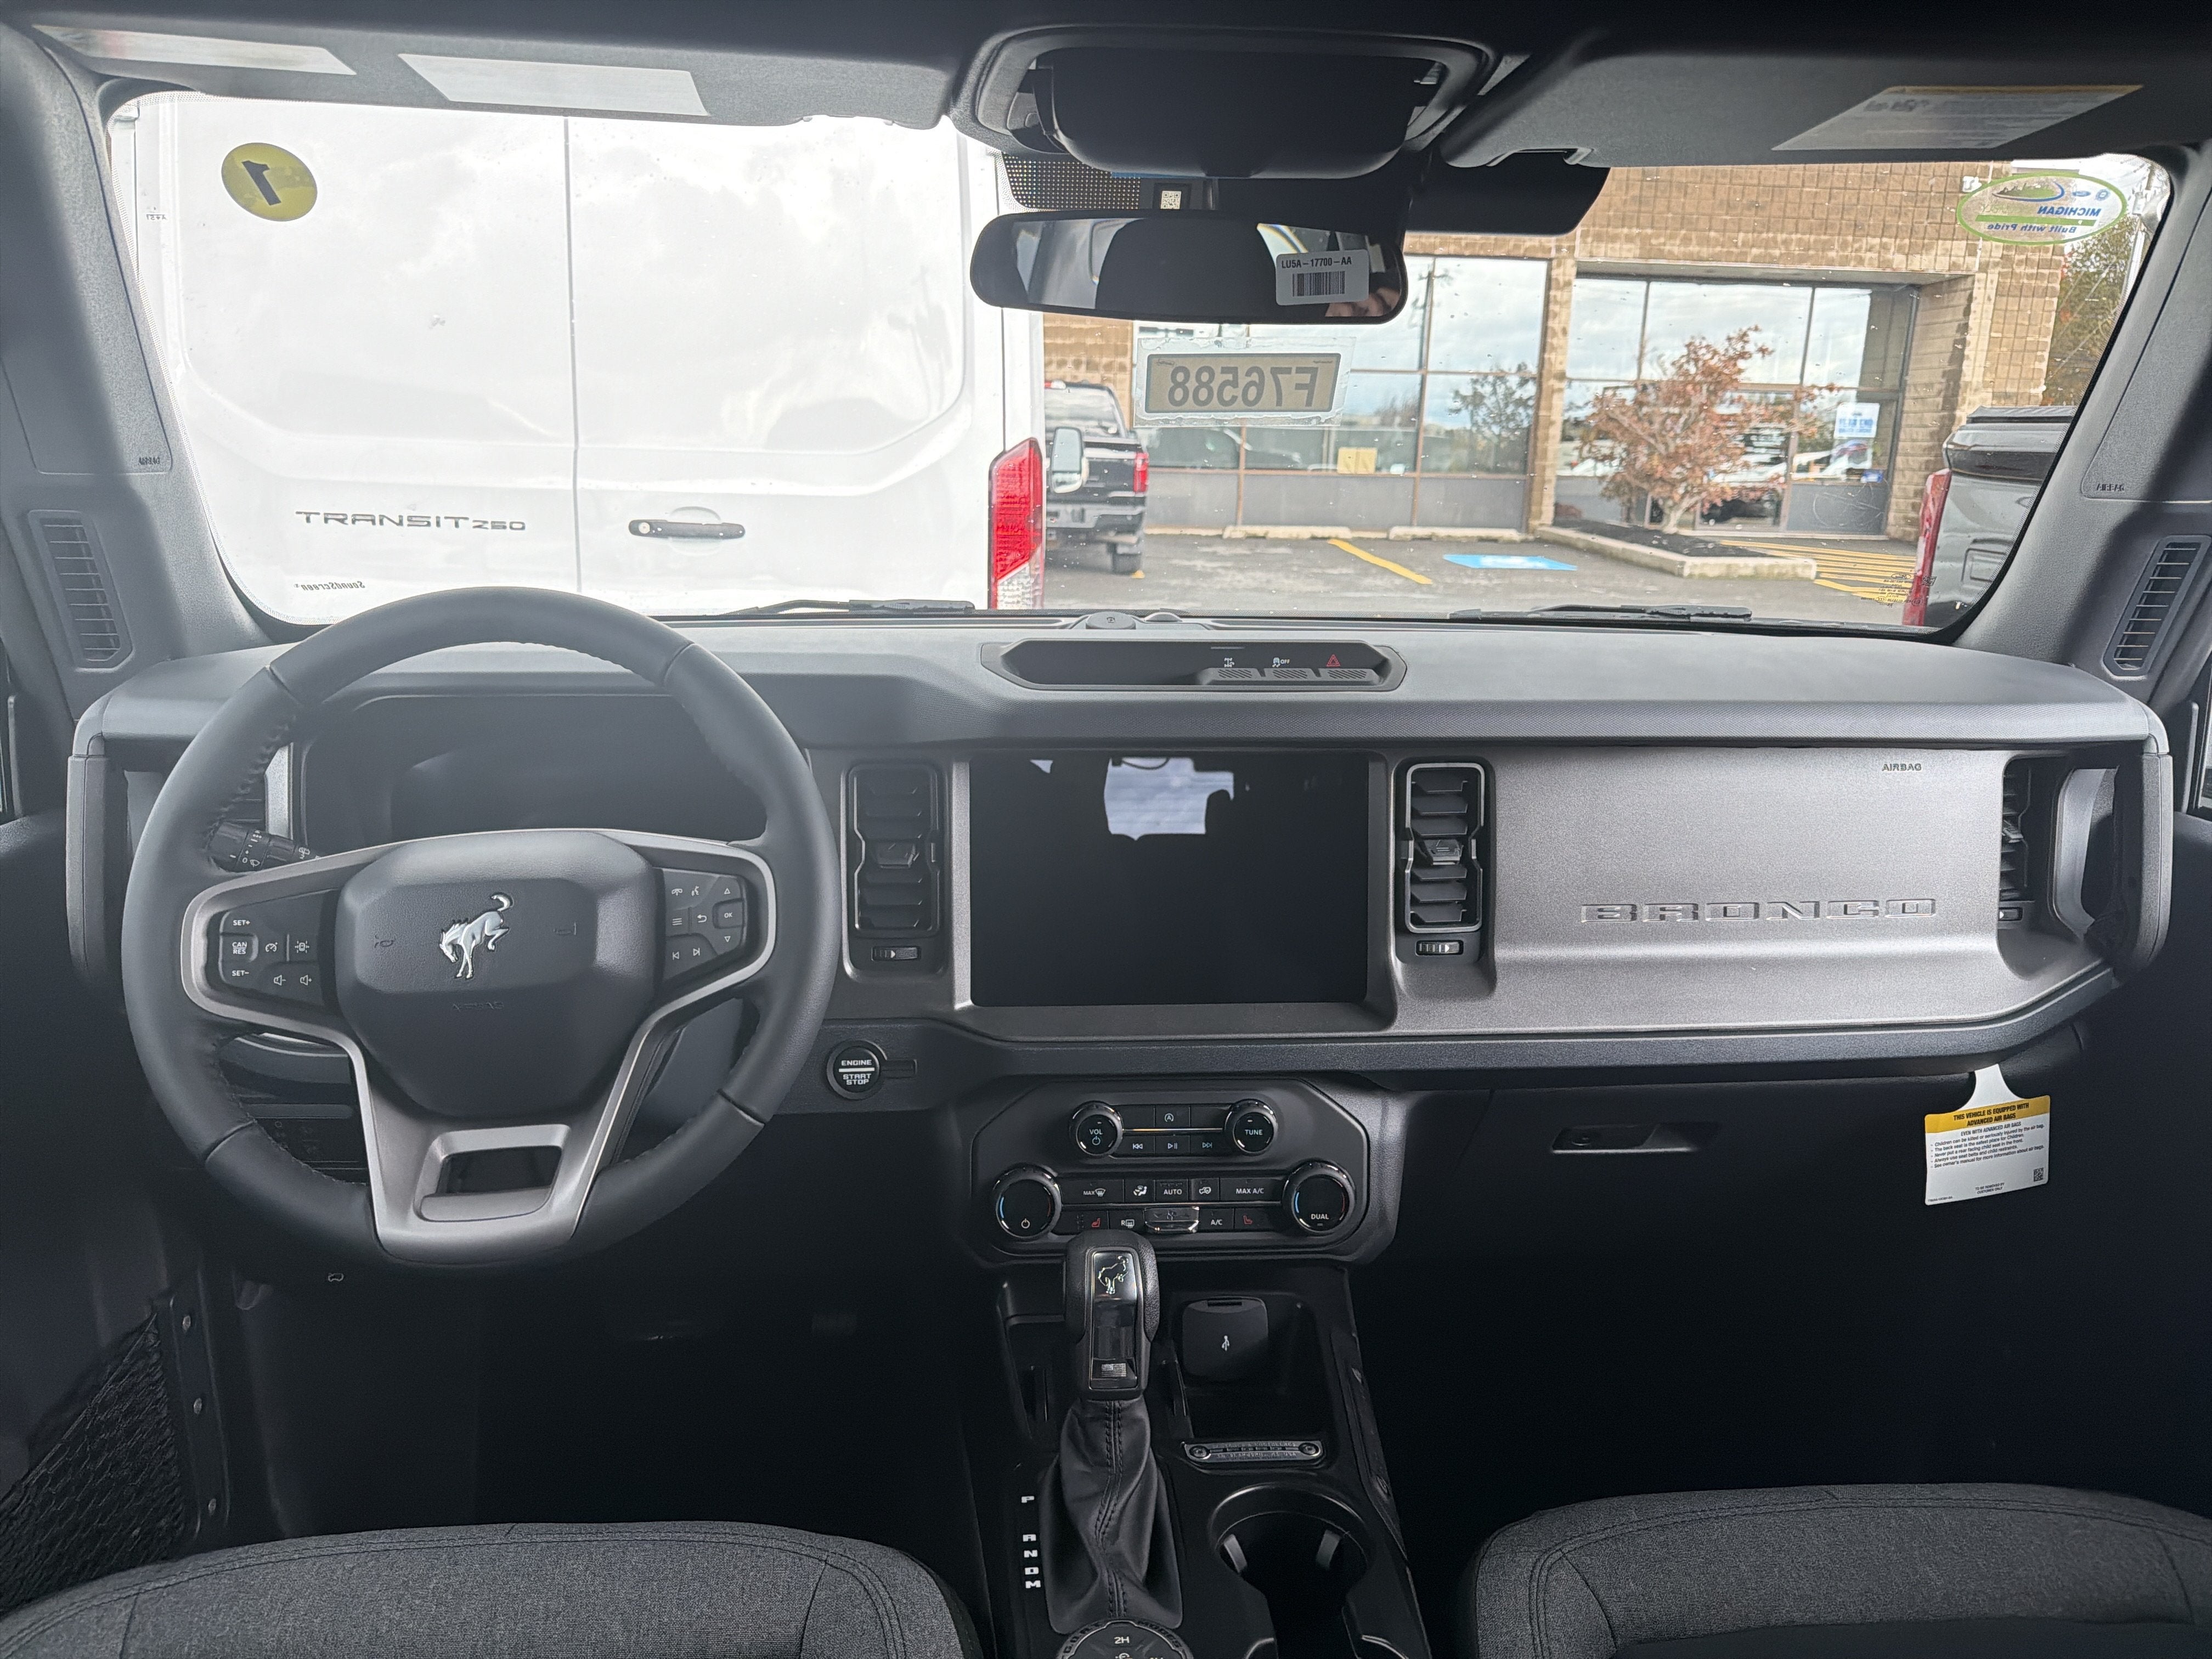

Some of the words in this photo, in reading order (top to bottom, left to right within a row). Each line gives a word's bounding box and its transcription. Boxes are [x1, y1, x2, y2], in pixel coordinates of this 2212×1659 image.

[1881, 763, 1922, 771] AIRBAG
[1581, 898, 1937, 923] BRONCO
[1966, 1110, 1985, 1119] VEHICLE
[1993, 1105, 2016, 1114] EQUIPPED
[1967, 1118, 1993, 1126] ADVANCED
[1024, 1549, 1038, 1558] N
[1024, 1567, 1039, 1575] D
[1025, 1580, 1041, 1589] M
[1114, 1636, 1130, 1644] 2H
